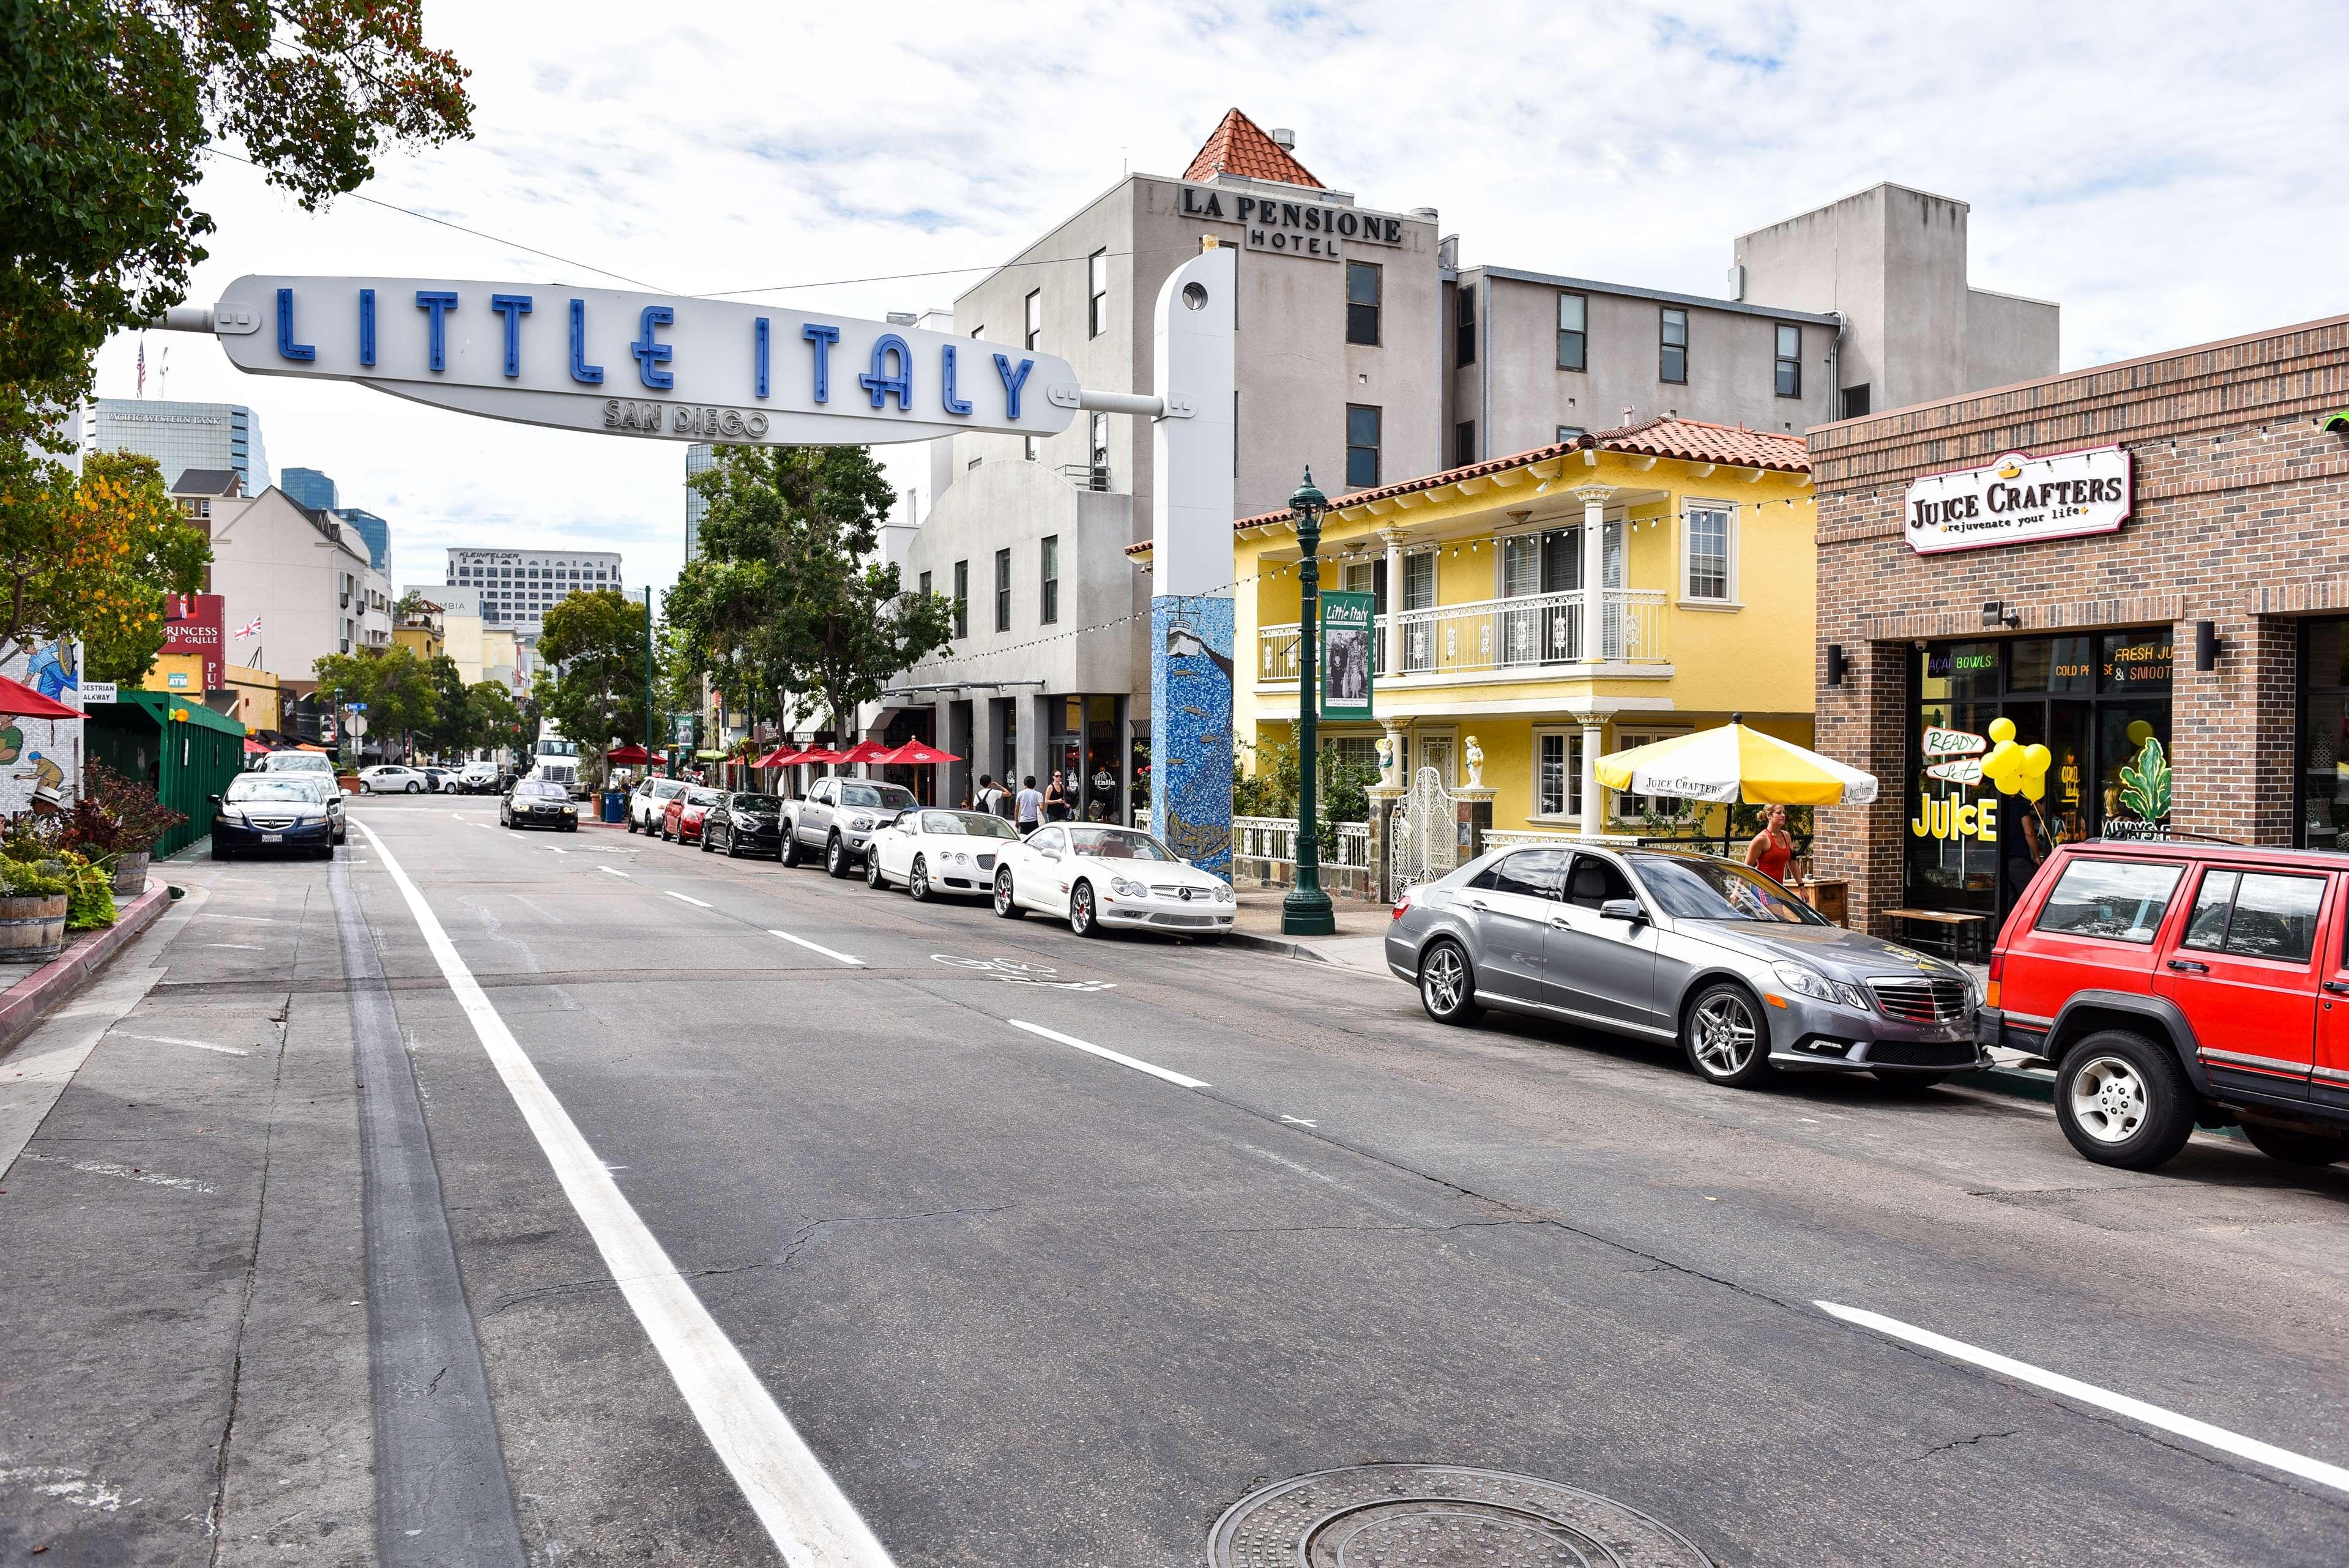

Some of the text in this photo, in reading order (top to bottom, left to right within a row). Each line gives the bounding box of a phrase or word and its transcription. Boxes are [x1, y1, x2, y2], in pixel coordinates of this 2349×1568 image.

[1183, 188, 1224, 217] LA
[1237, 196, 1402, 243] PENSIONE
[1251, 229, 1339, 256] HOTEL
[277, 288, 1035, 420] LITTLE ITALY
[108, 413, 221, 425] PACIFIC WESTERN BANK
[603, 399, 770, 437] SAN DIEGO
[1910, 477, 2122, 529] JUICE CRAFTERS
[1947, 507, 2080, 533] rejuvenate your life
[1326, 599, 1369, 630] Little Italy
[160, 626, 218, 636] RINCESS
[1956, 655, 1992, 669] BOWLS
[2115, 647, 2154, 662] FRESH
[2056, 665, 2077, 677] COLD
[2115, 667, 2125, 681] &
[1929, 732, 1979, 752] READY
[1933, 762, 1980, 781] Set
[1646, 778, 1723, 794] JUICE CRAFTERS
[1912, 792, 1998, 842] JUICE
